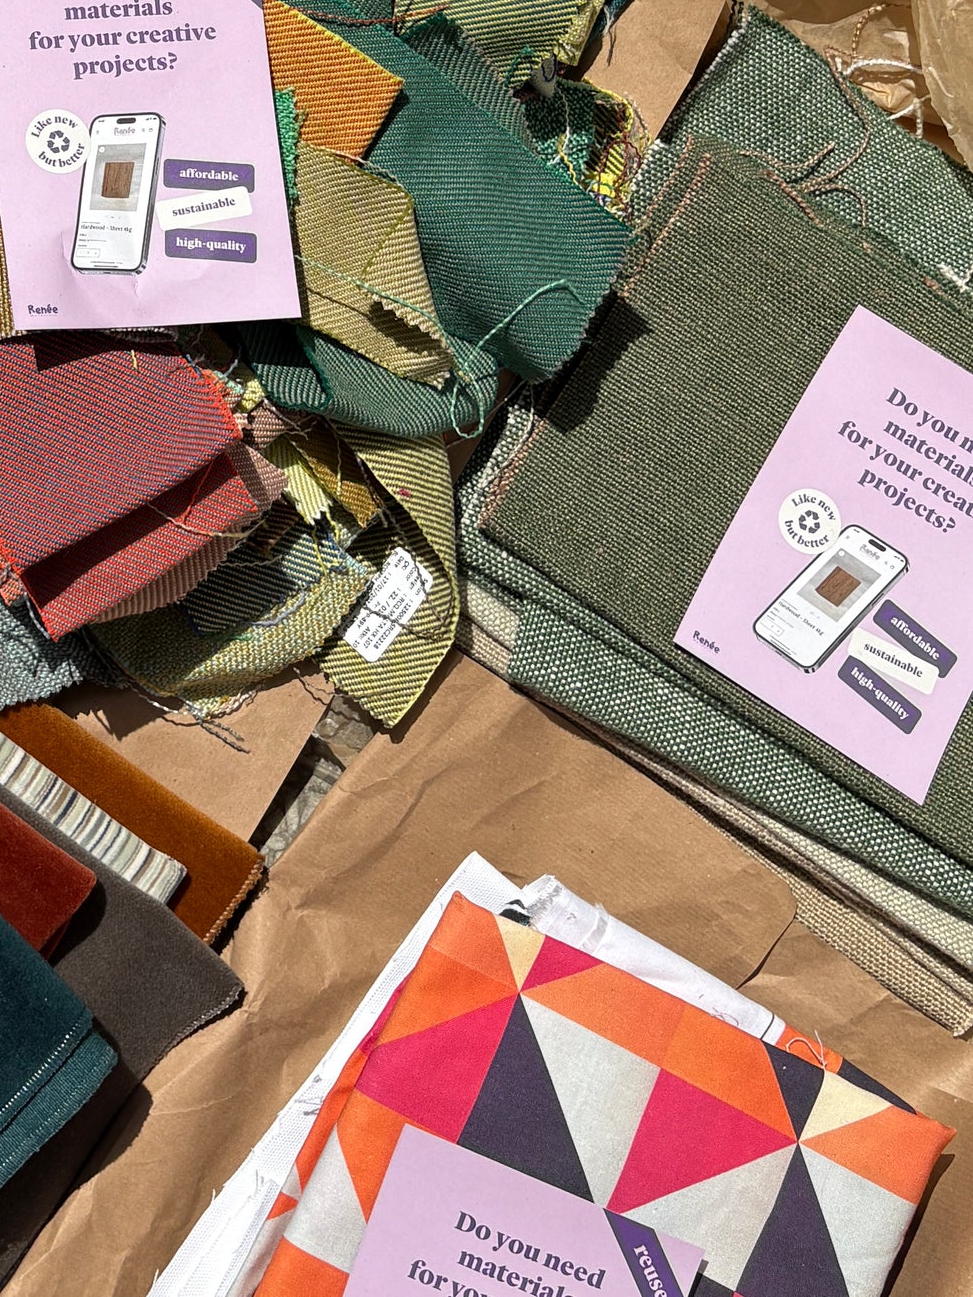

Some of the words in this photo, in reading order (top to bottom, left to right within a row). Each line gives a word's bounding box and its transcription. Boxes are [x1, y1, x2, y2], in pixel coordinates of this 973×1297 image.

[28, 31, 65, 50] for
[68, 32, 122, 53] your
[126, 23, 217, 44] creative
[73, 52, 178, 80] projects?
[30, 117, 53, 139] Like
[53, 115, 79, 129] new
[37, 150, 57, 168] but
[57, 142, 86, 169] better
[179, 168, 239, 181] affordable
[171, 197, 236, 216] sustainable
[176, 237, 246, 253] high-quality
[886, 387, 918, 416] Do
[916, 410, 960, 443] you
[838, 421, 873, 450] for
[869, 444, 923, 482] your
[883, 421, 973, 487] material
[790, 492, 817, 508] Like
[817, 499, 837, 521] new
[857, 469, 956, 533] projects?
[783, 519, 799, 540] but
[796, 534, 830, 549] better
[361, 636, 373, 649] 107
[890, 617, 939, 660] affordable
[863, 644, 924, 677] sustainable
[851, 667, 909, 720] high-quality
[454, 1211, 491, 1240] Do
[492, 1231, 541, 1263] you
[542, 1253, 606, 1290] need
[407, 1260, 448, 1291] for
